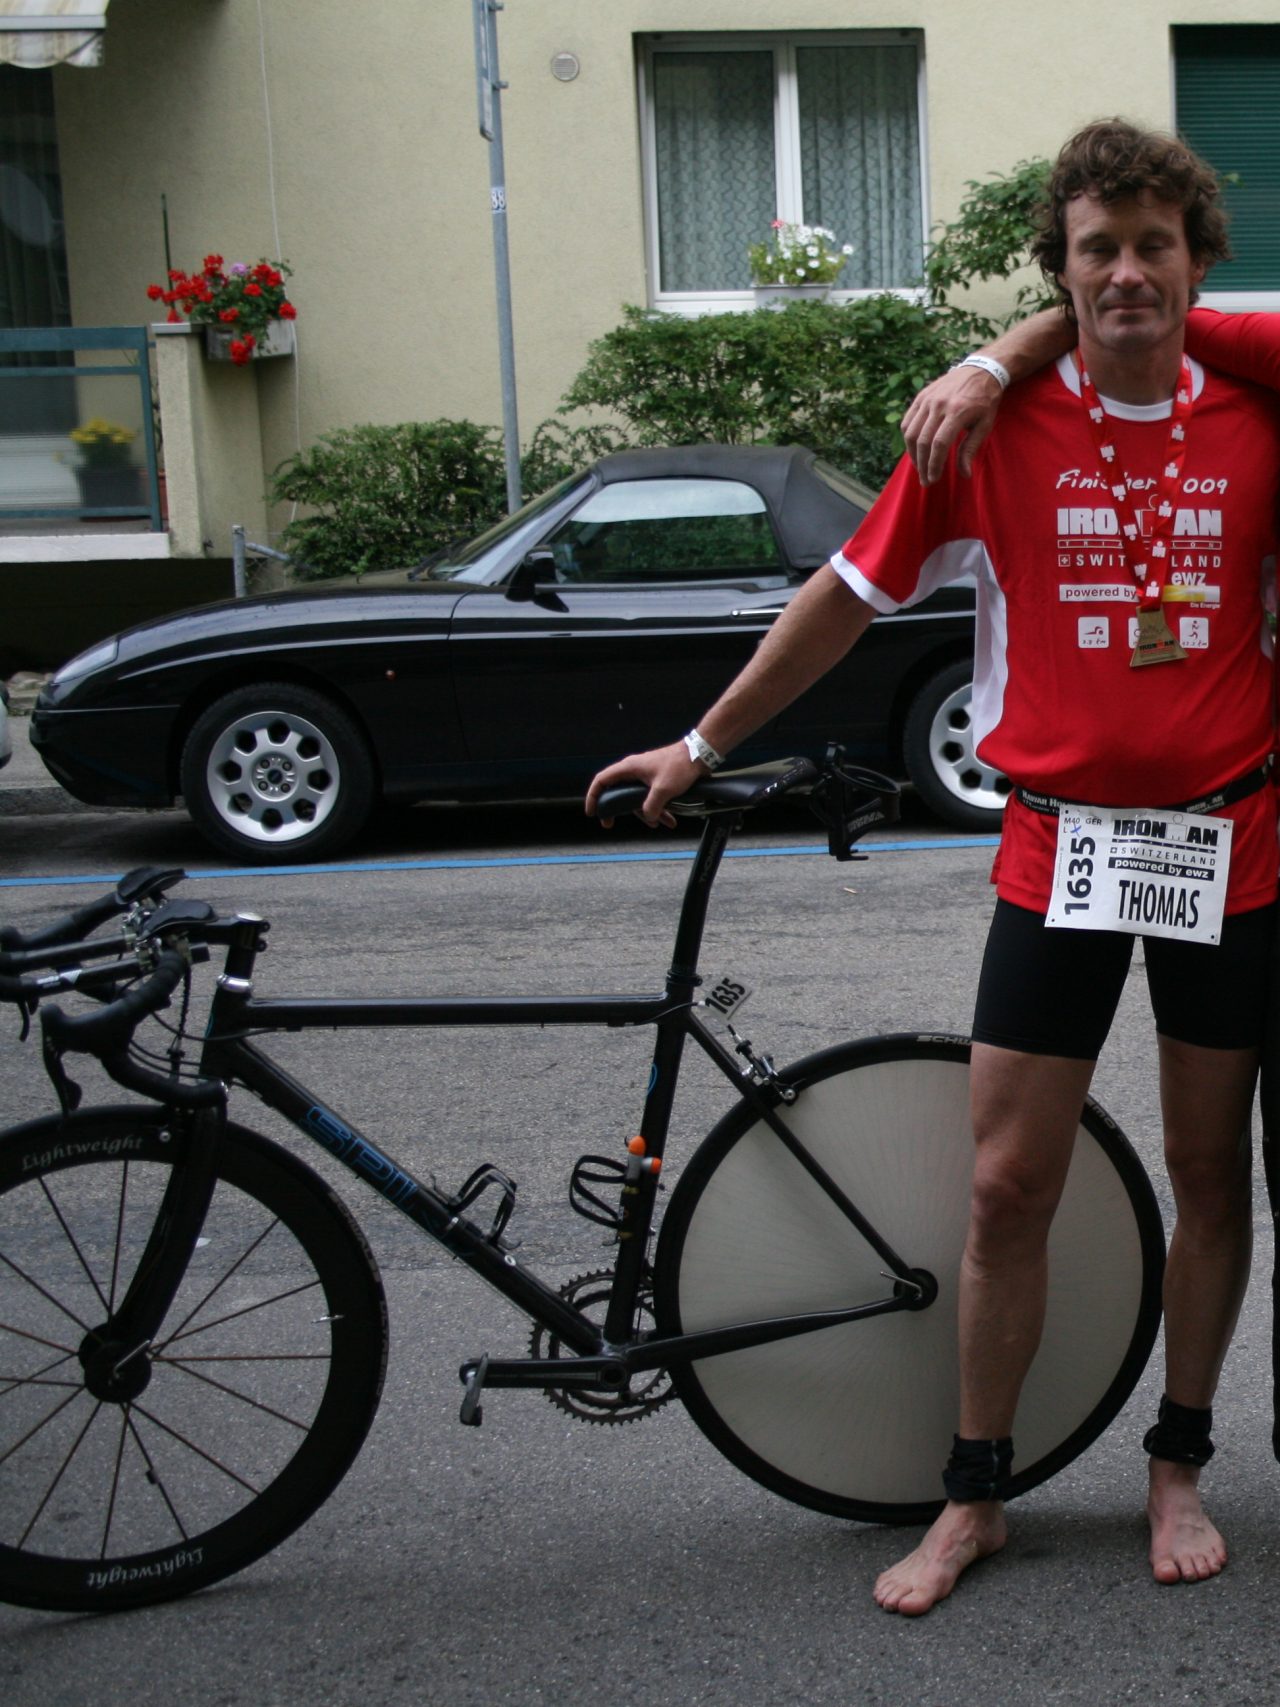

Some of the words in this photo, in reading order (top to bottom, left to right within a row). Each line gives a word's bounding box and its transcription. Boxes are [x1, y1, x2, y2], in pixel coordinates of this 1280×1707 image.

[1076, 553, 1221, 568] SWITLAND
[1065, 586, 1119, 598] powered
[1123, 587, 1136, 599] by
[1171, 571, 1206, 587] ewz
[1085, 817, 1102, 827] GER
[1115, 860, 1164, 873] powered
[1168, 864, 1182, 877] by
[1185, 869, 1209, 879] ewz
[1121, 846, 1216, 867] SWITZERLAND
[1064, 836, 1096, 915] 1635
[1118, 879, 1201, 929] THOMAS
[704, 977, 747, 1015] 1635
[22, 1134, 144, 1172] Lightweight
[87, 1547, 204, 1589] Lightweight
